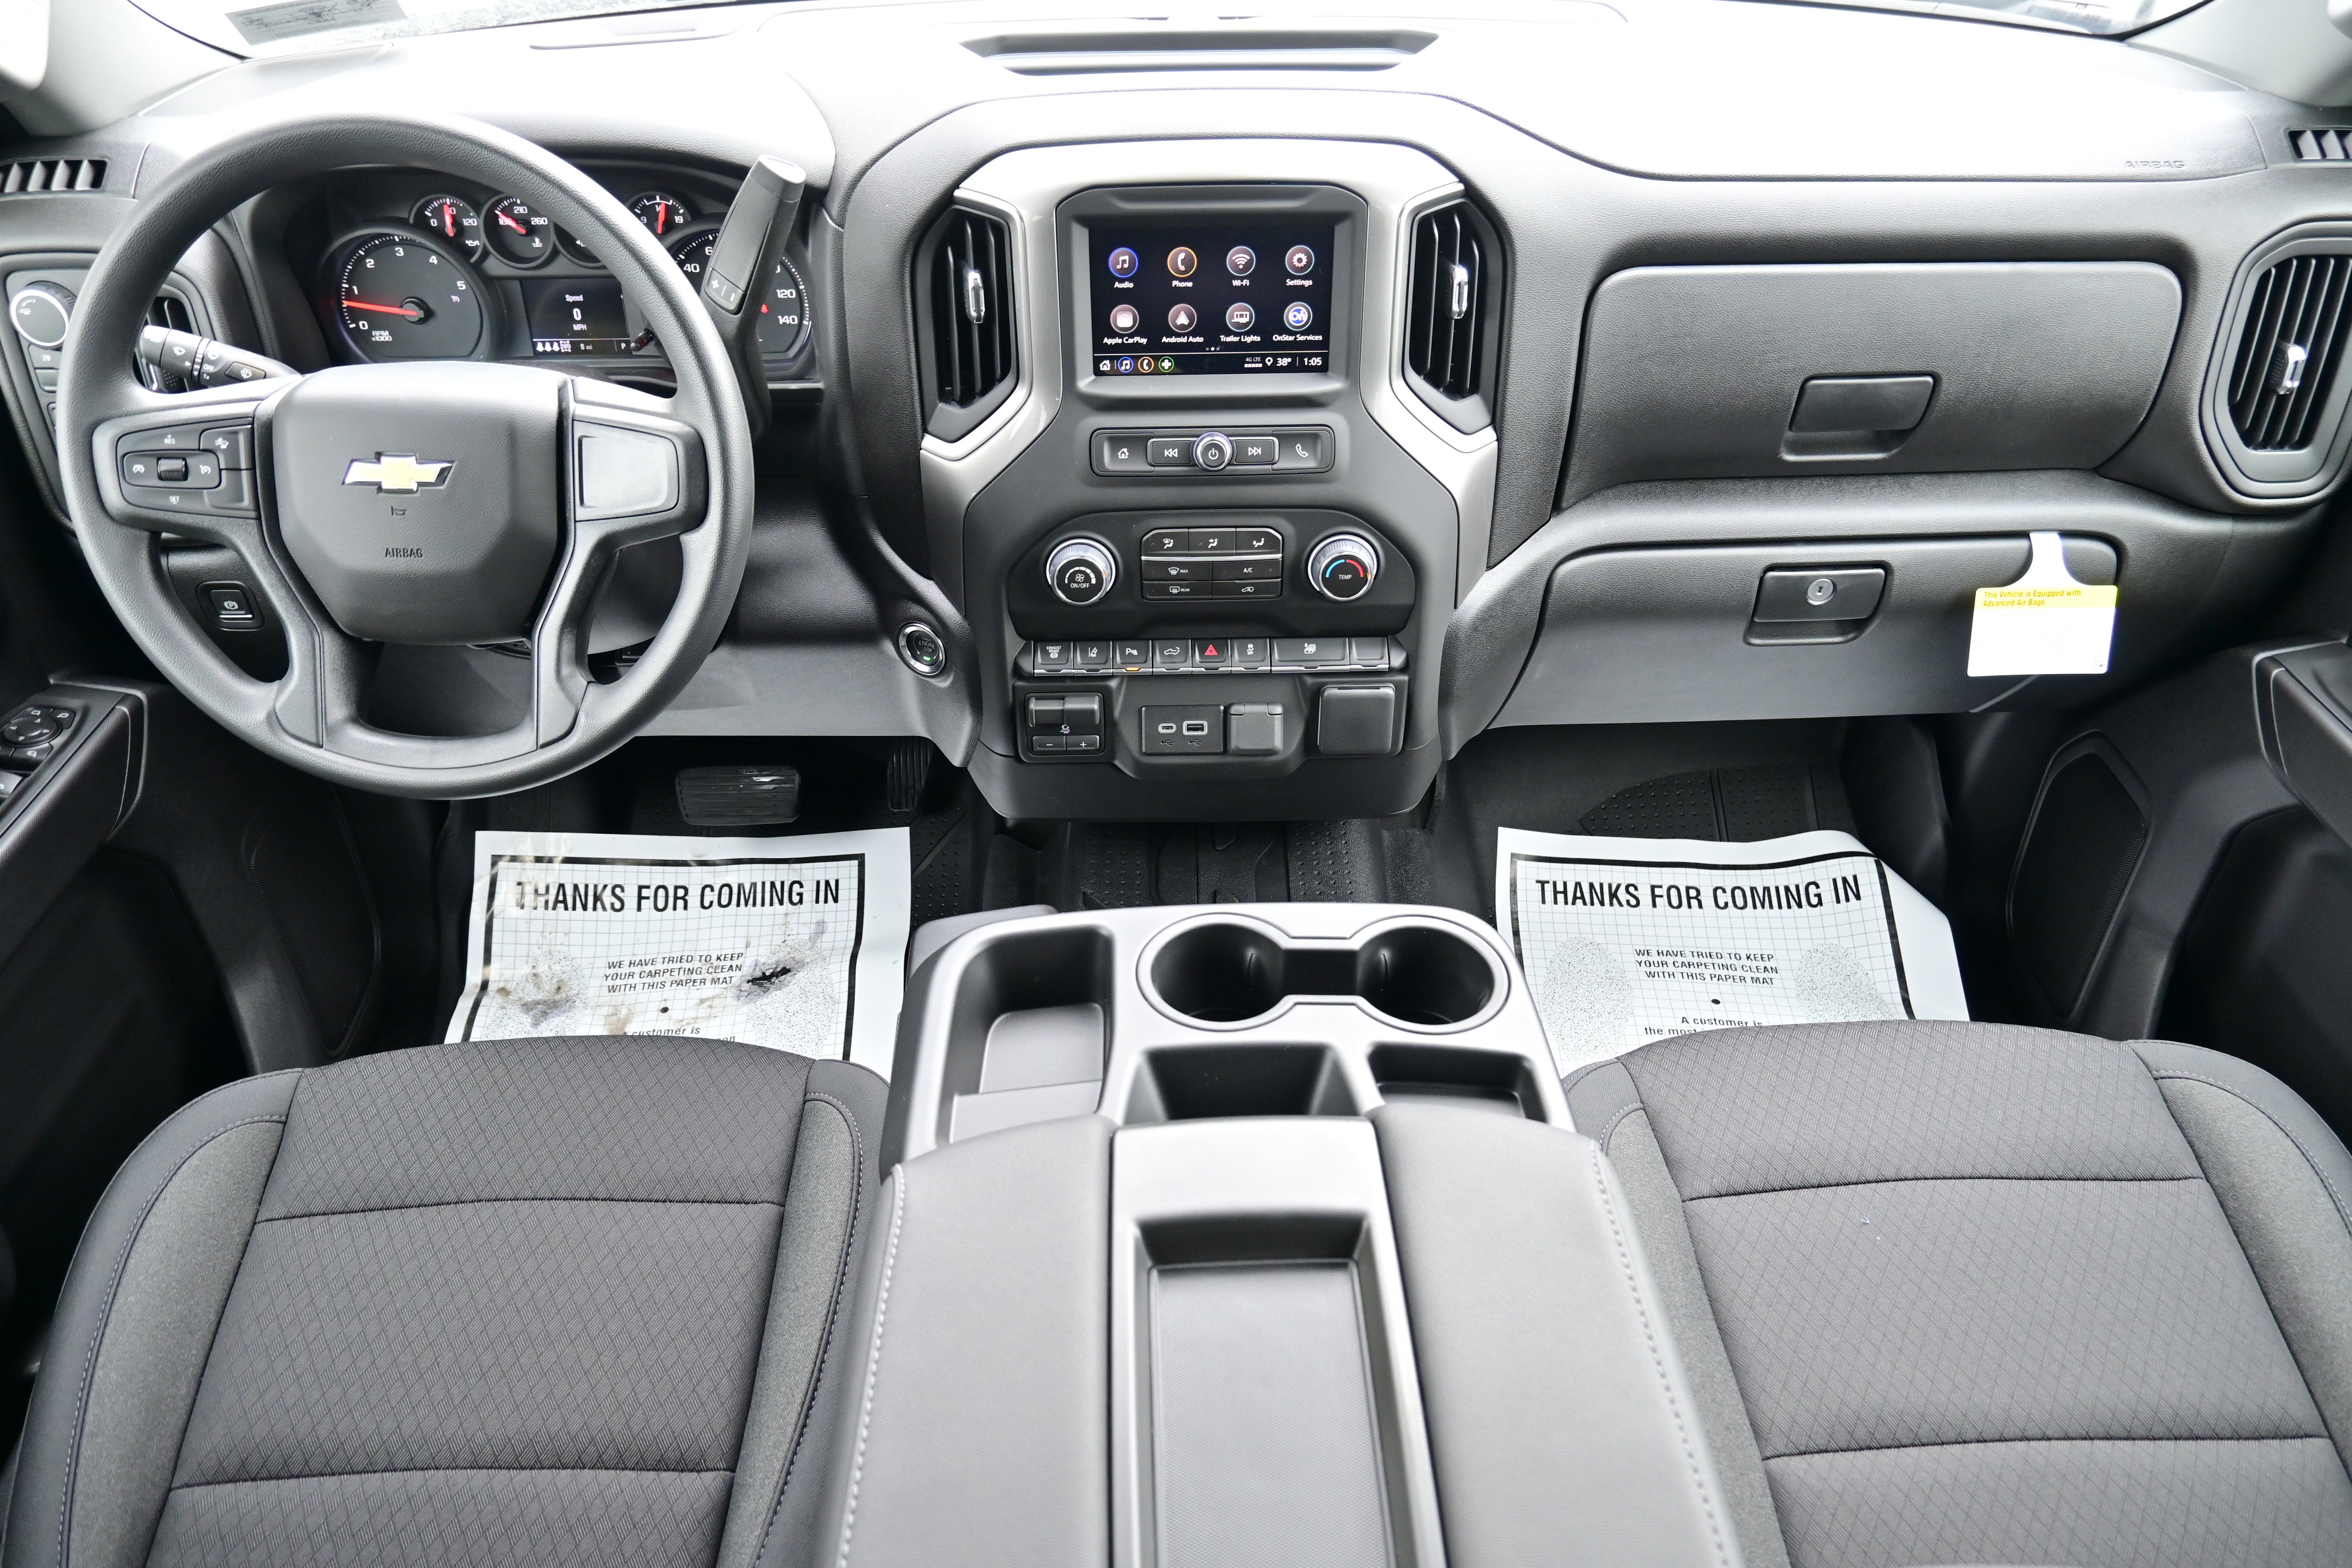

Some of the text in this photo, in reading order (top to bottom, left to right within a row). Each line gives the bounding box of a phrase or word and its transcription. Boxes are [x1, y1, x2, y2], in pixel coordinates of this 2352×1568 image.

[2125, 161, 2185, 169] AIRBAG
[531, 217, 548, 225] 260
[395, 247, 404, 256] 3
[705, 247, 713, 256] 6
[366, 259, 375, 268] 2
[429, 256, 438, 265] 4
[683, 264, 700, 272] 40
[457, 281, 466, 290] 5
[1286, 279, 1313, 287] Settings
[352, 286, 358, 295] 1
[776, 289, 796, 298] 120
[565, 294, 583, 302] Speed
[573, 308, 582, 321] 0
[778, 316, 798, 324] 140
[359, 321, 368, 330] 0
[1103, 337, 1147, 345] Apple CarPlay
[1241, 335, 1261, 343] Lights
[1304, 357, 1322, 366] 1:05
[385, 548, 423, 558] AIRBAG
[919, 640, 935, 649] ENGINE
[517, 879, 839, 912] THANKS FOR COMING IN
[1535, 874, 1861, 909] THANKS FOR COMING IN
[1635, 949, 1774, 962] WE HAVE TRIED TO KEEP
[607, 953, 744, 969] WE HAVE TRIED TO KEEP
[1636, 960, 1778, 974] YOUR CARPETING CLEAN
[604, 964, 743, 981] YOUR CARPETING CLEAN
[1645, 971, 1775, 985] WITH THIS PAPER MAT
[607, 976, 735, 993] WITH THIS PAPER MAT
[1693, 1018, 1749, 1027] customer
[691, 1026, 700, 1034] is
[1644, 1027, 1663, 1035] the
